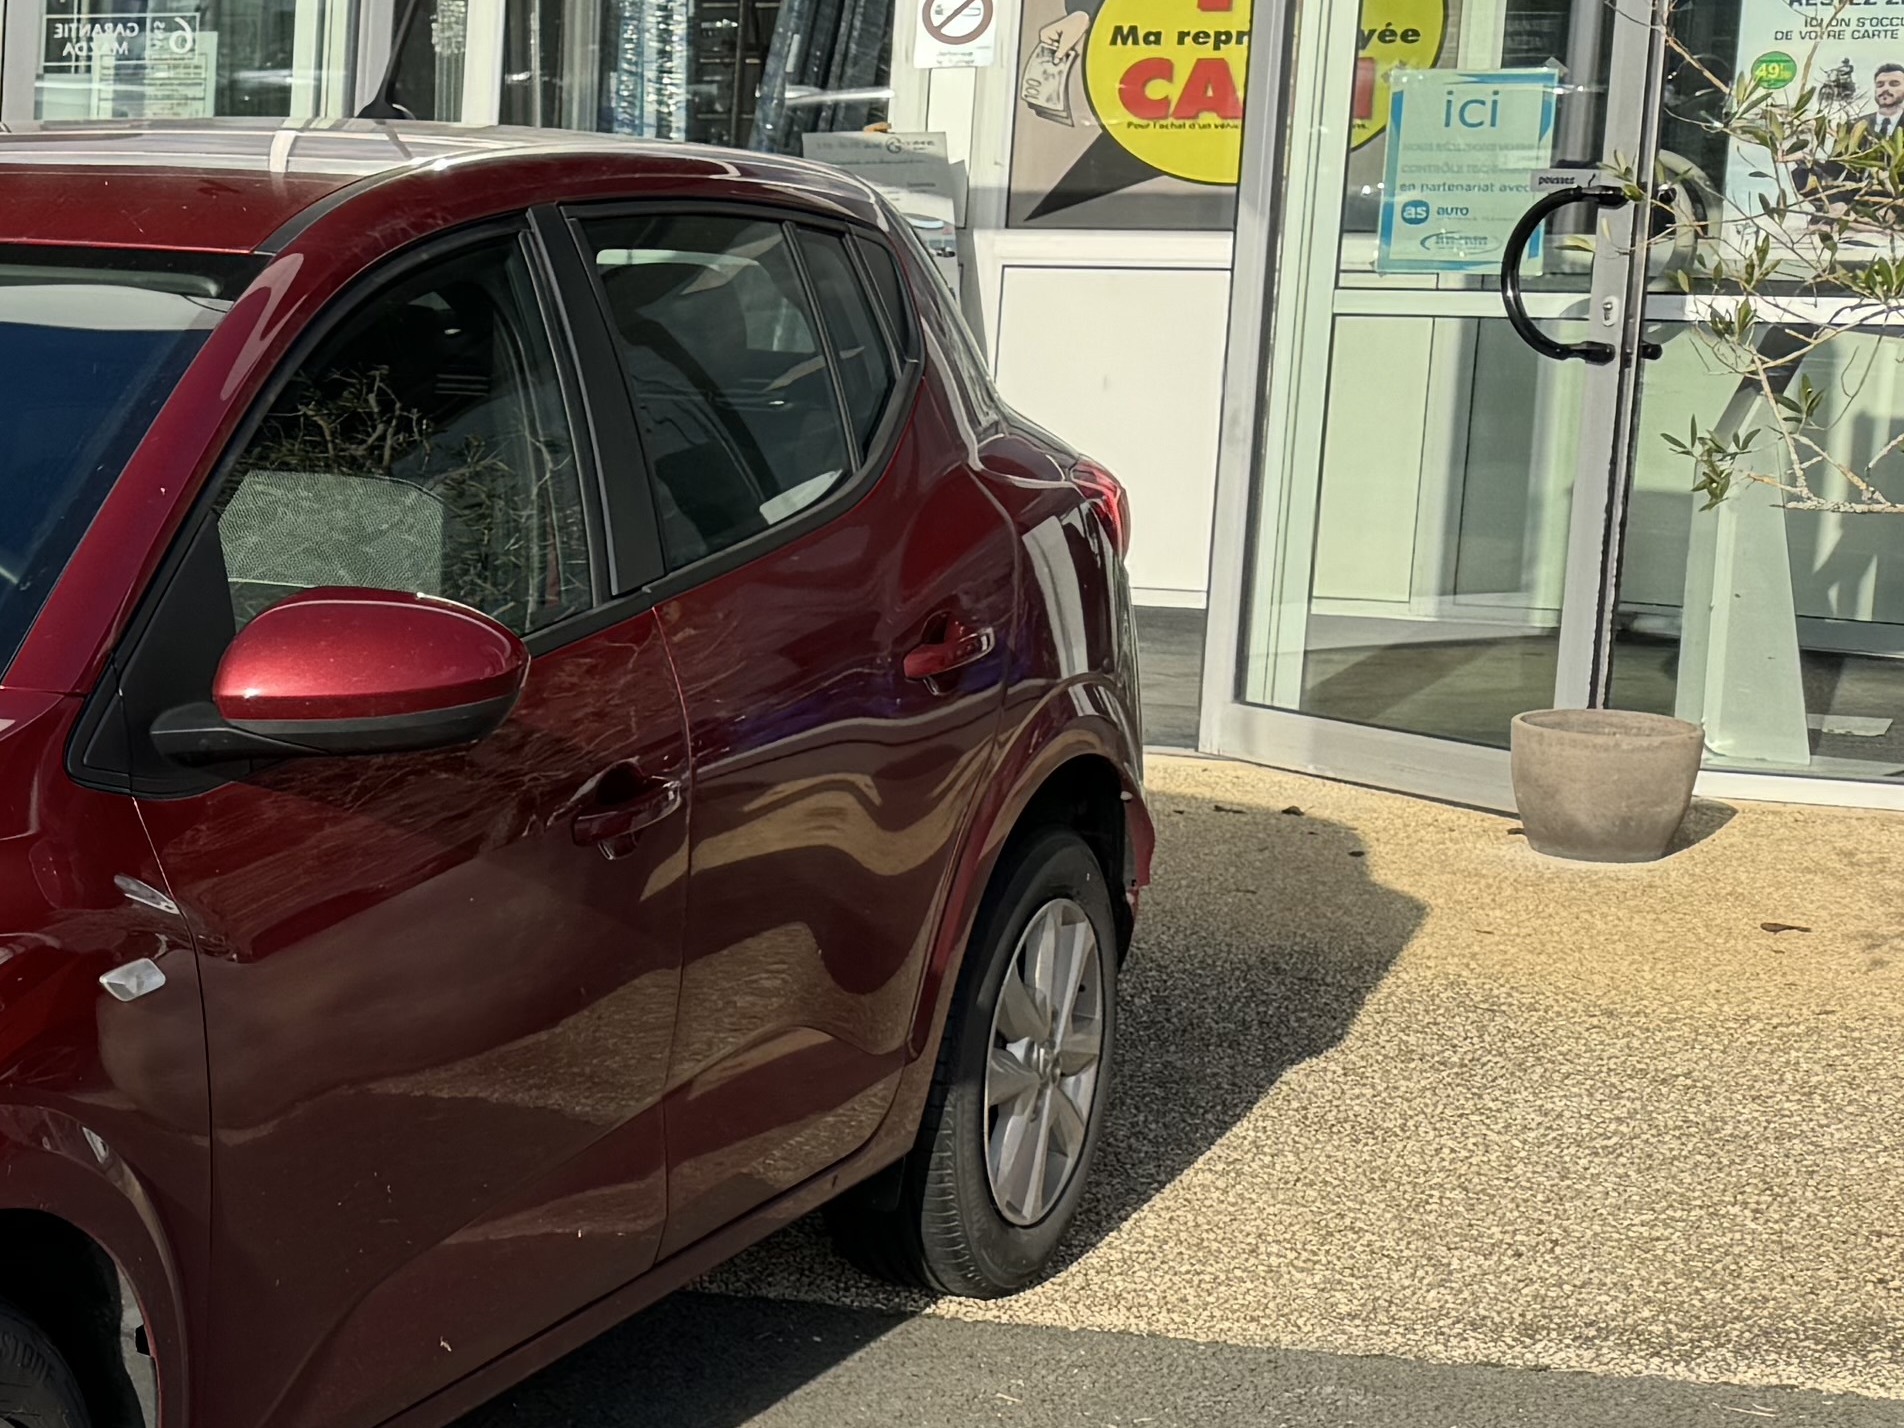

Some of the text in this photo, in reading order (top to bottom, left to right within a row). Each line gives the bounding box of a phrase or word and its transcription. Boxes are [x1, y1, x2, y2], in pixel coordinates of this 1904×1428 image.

[1855, 16, 1904, 29] S'OCCU
[1109, 24, 1163, 47] Ma
[1176, 29, 1251, 52] repr
[1774, 30, 1794, 41] DE
[1851, 28, 1900, 41] CARTE
[1443, 89, 1500, 129] ici
[1403, 205, 1427, 220] as
